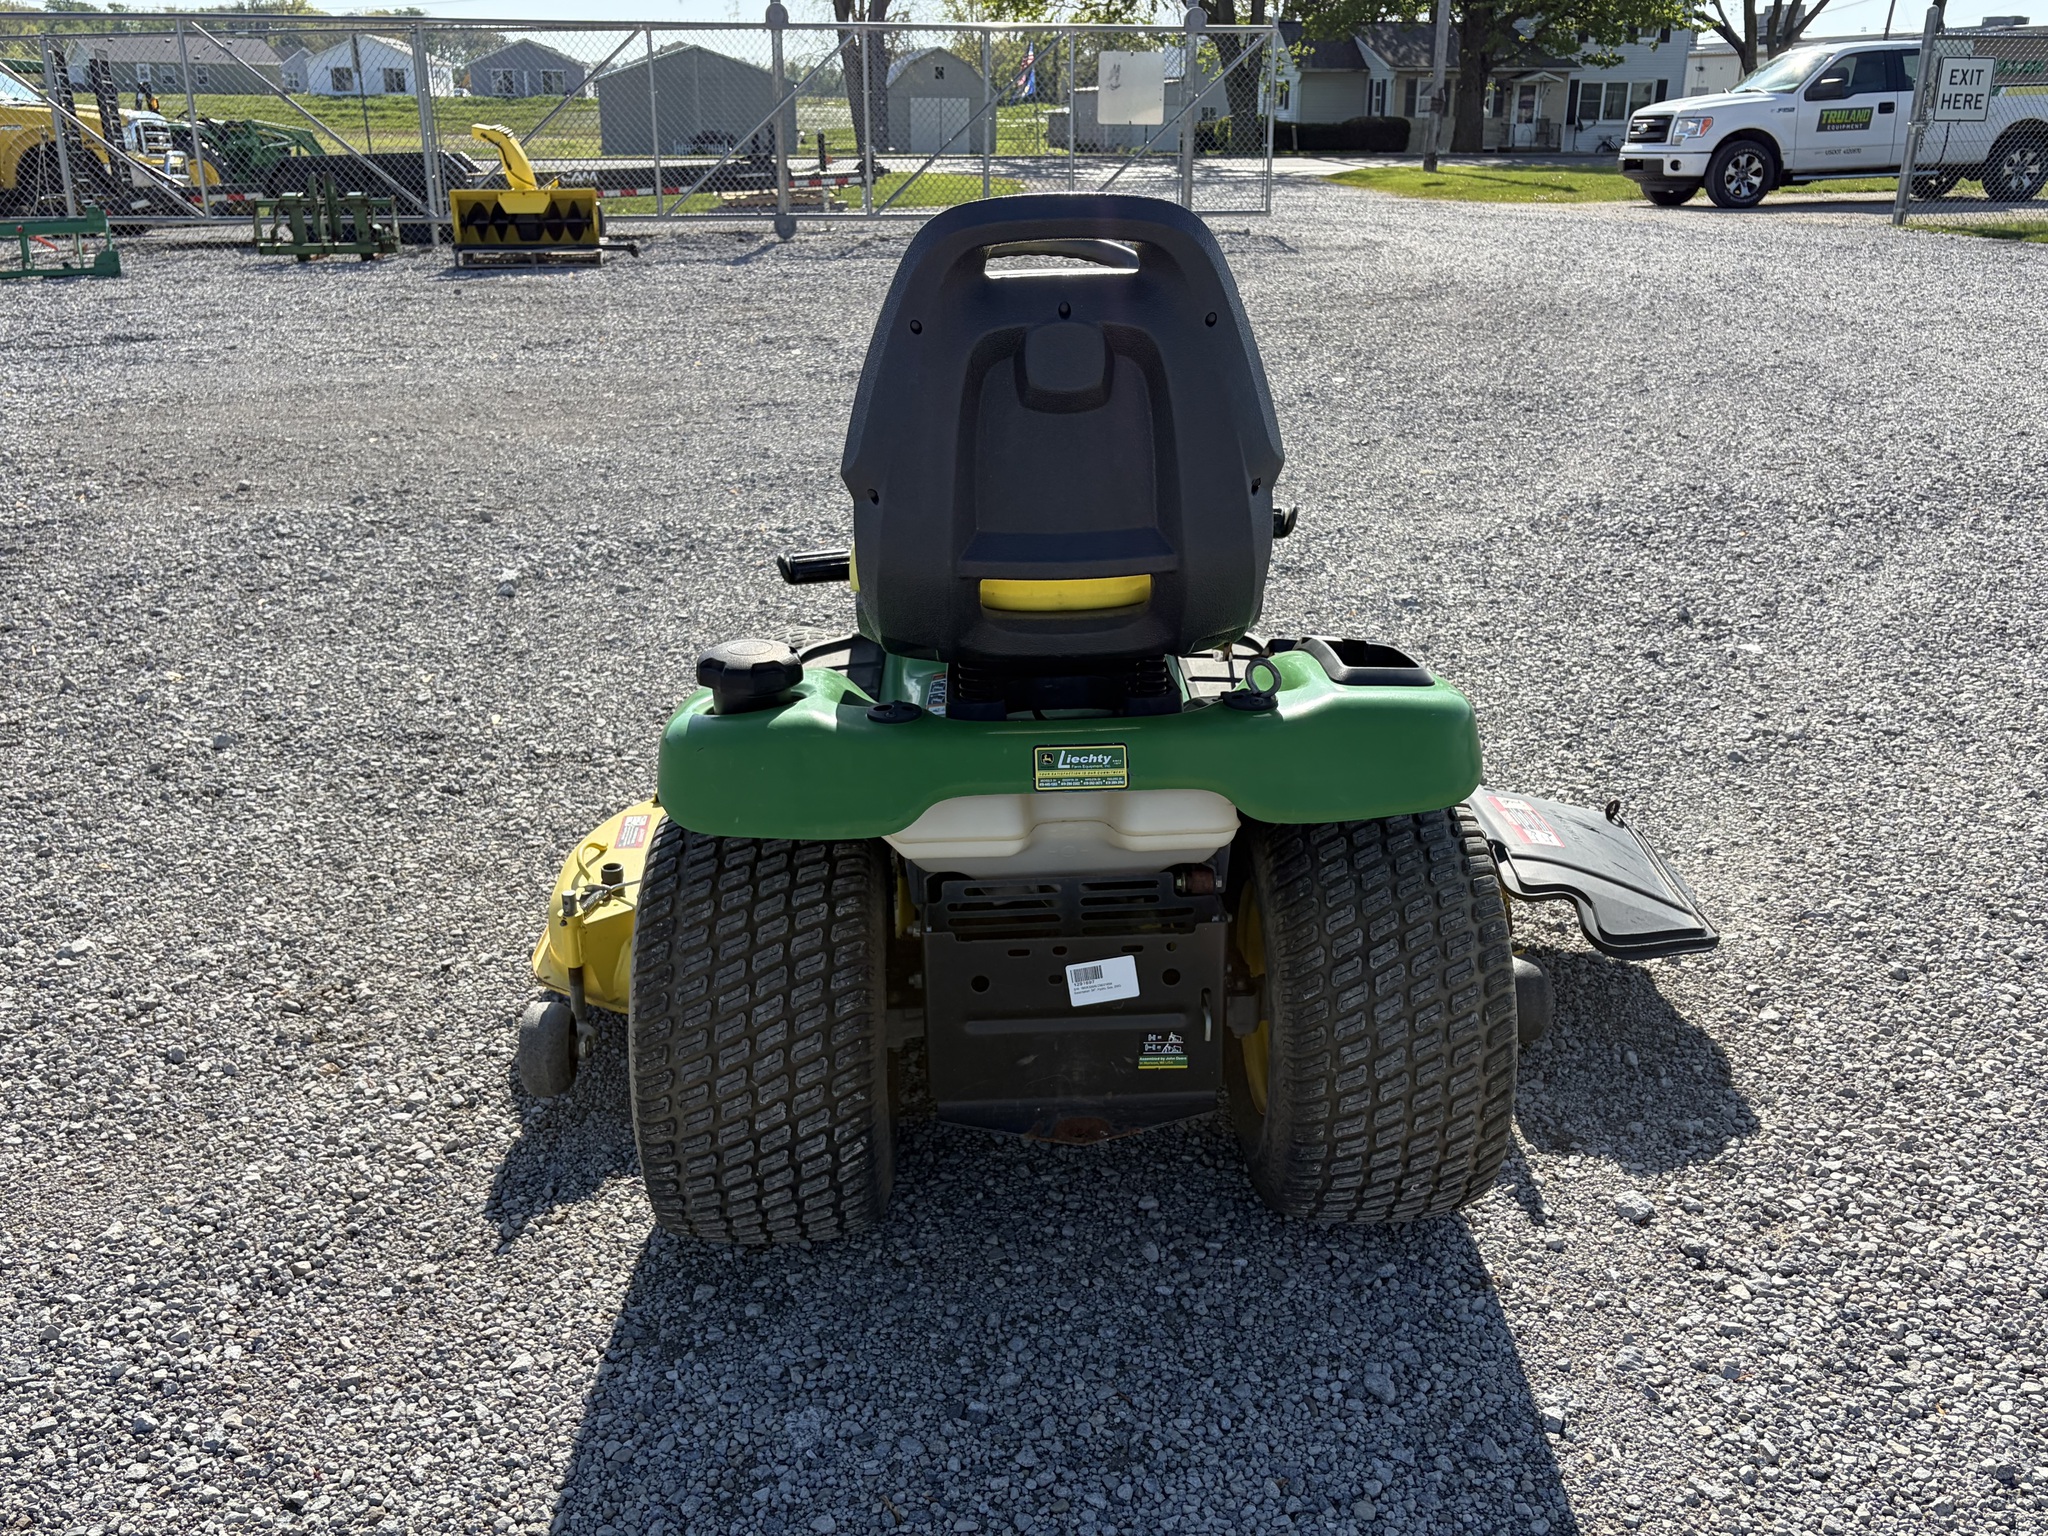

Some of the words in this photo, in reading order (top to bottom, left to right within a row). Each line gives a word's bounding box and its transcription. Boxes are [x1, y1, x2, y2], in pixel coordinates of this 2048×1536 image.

[1949, 68, 1985, 86] EXIT
[1940, 93, 1985, 110] HERE
[1821, 109, 1871, 124] TRULAND
[1057, 750, 1112, 769] Liechty
